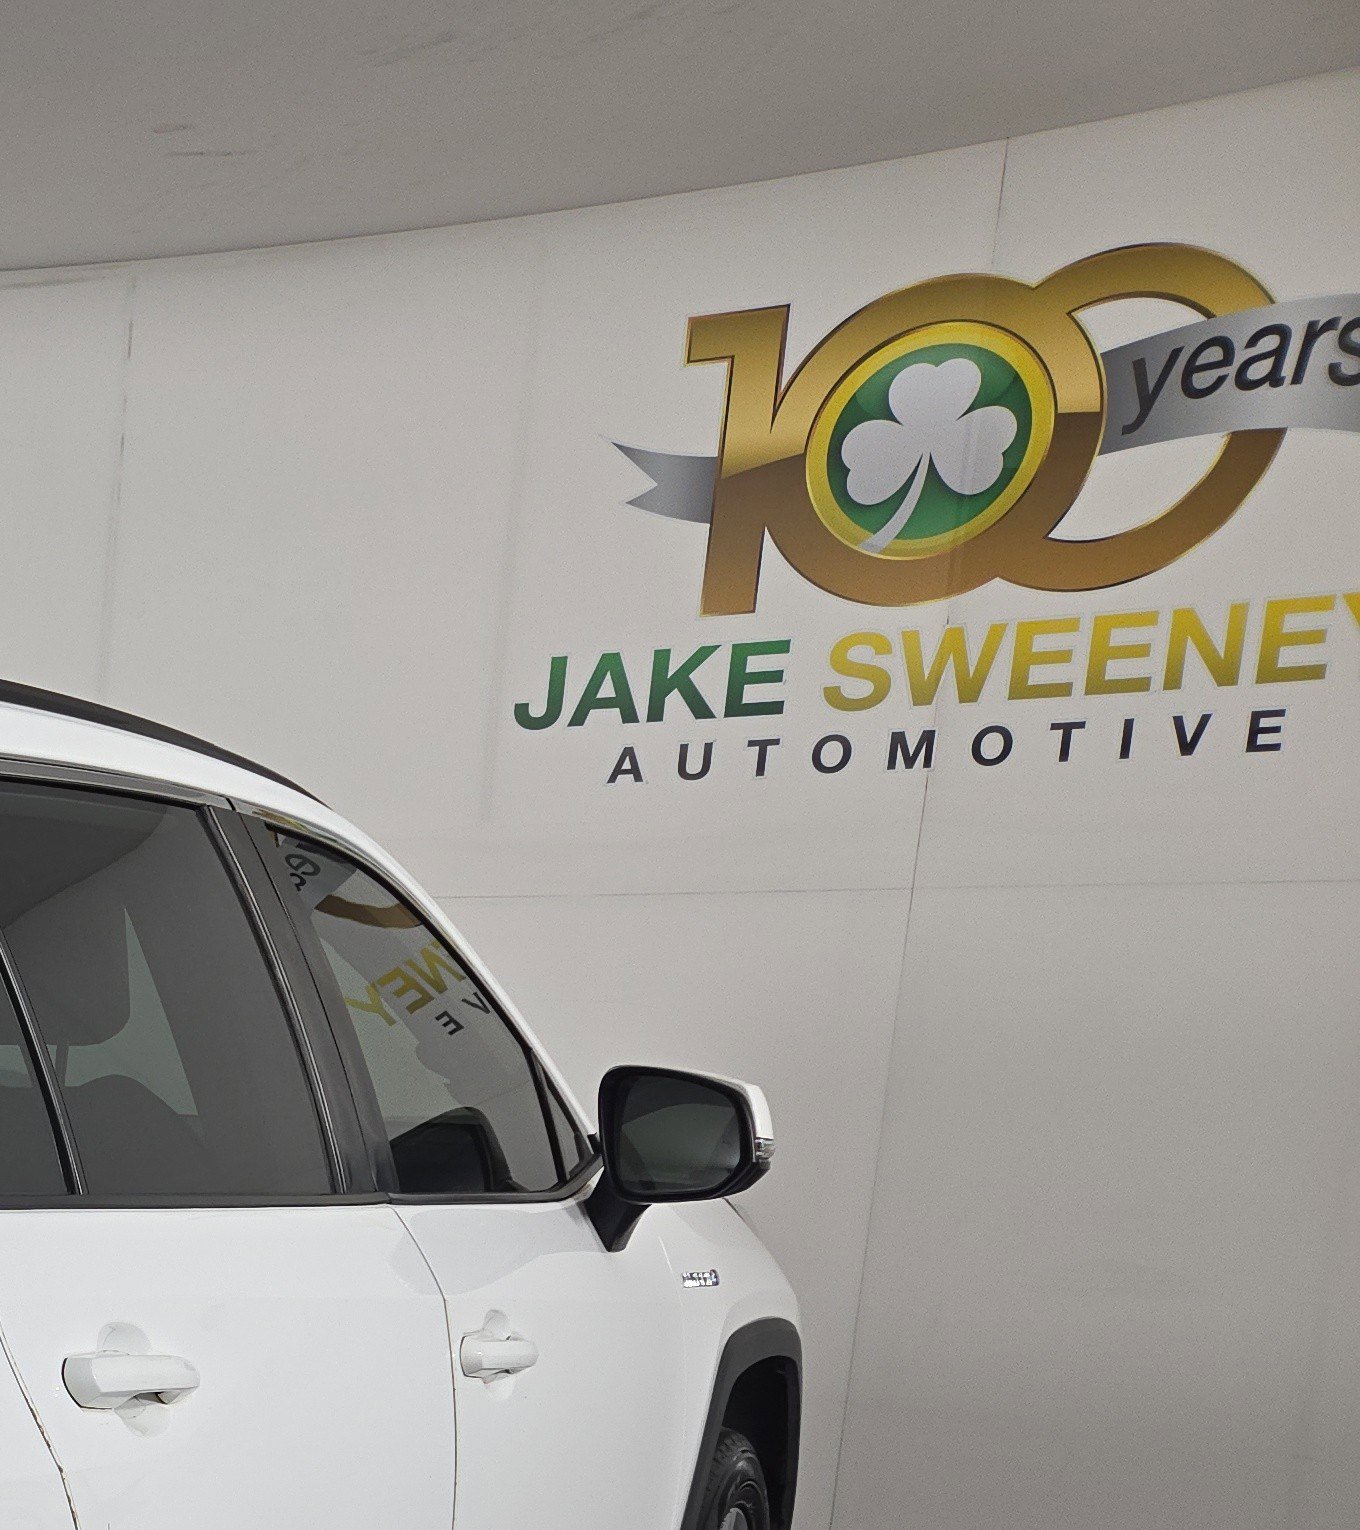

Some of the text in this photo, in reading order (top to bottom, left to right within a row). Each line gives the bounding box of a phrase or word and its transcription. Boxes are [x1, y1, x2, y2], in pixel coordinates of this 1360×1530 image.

[684, 241, 1360, 617] 100 years
[513, 590, 1360, 731] JAKE SWEENE
[606, 708, 1287, 785] AUTOMOTIVE
